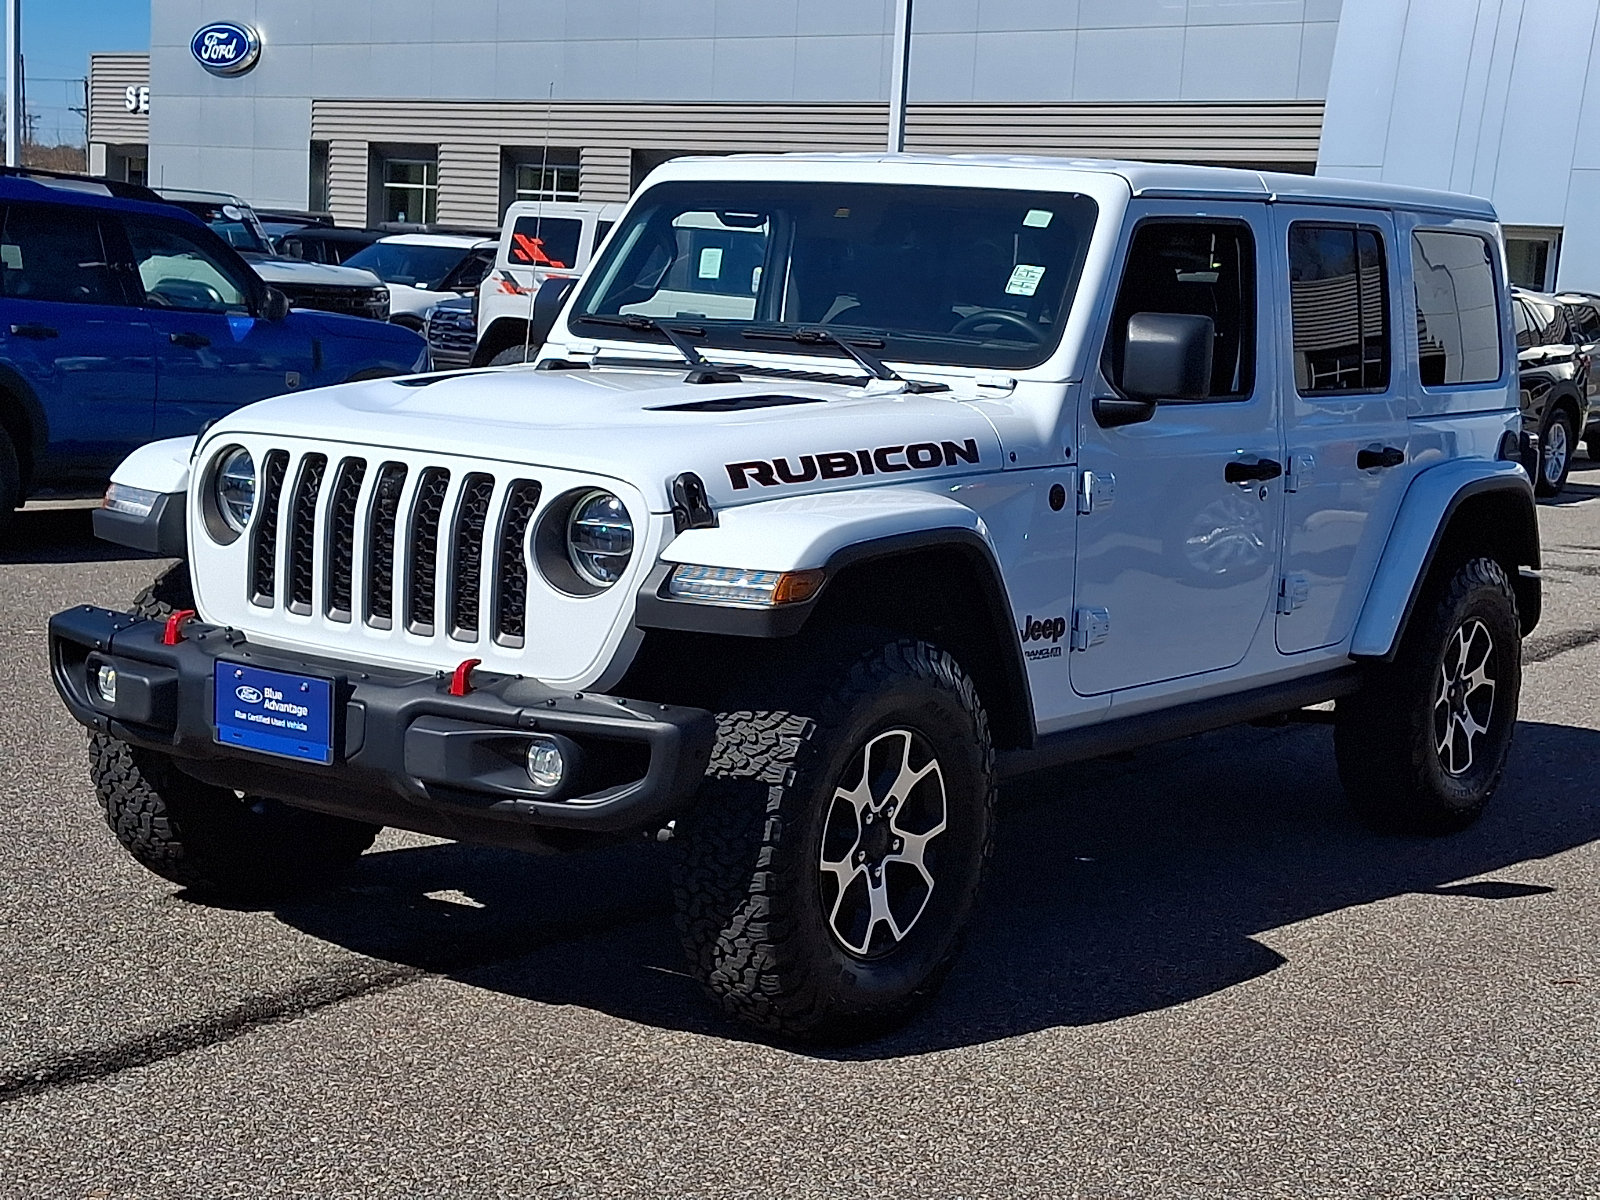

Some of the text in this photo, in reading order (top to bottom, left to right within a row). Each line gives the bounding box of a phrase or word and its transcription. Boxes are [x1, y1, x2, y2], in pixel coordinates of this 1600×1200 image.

[201, 32, 237, 59] Ford
[125, 86, 149, 111] SE
[725, 438, 980, 490] RUBICON
[1020, 615, 1065, 643] Jeep
[240, 688, 257, 700] Ford
[264, 687, 283, 700] Blue
[264, 699, 308, 717] Advantage
[248, 713, 270, 724] Certified
[271, 717, 285, 727] Used
[287, 720, 307, 731] Vehicle
